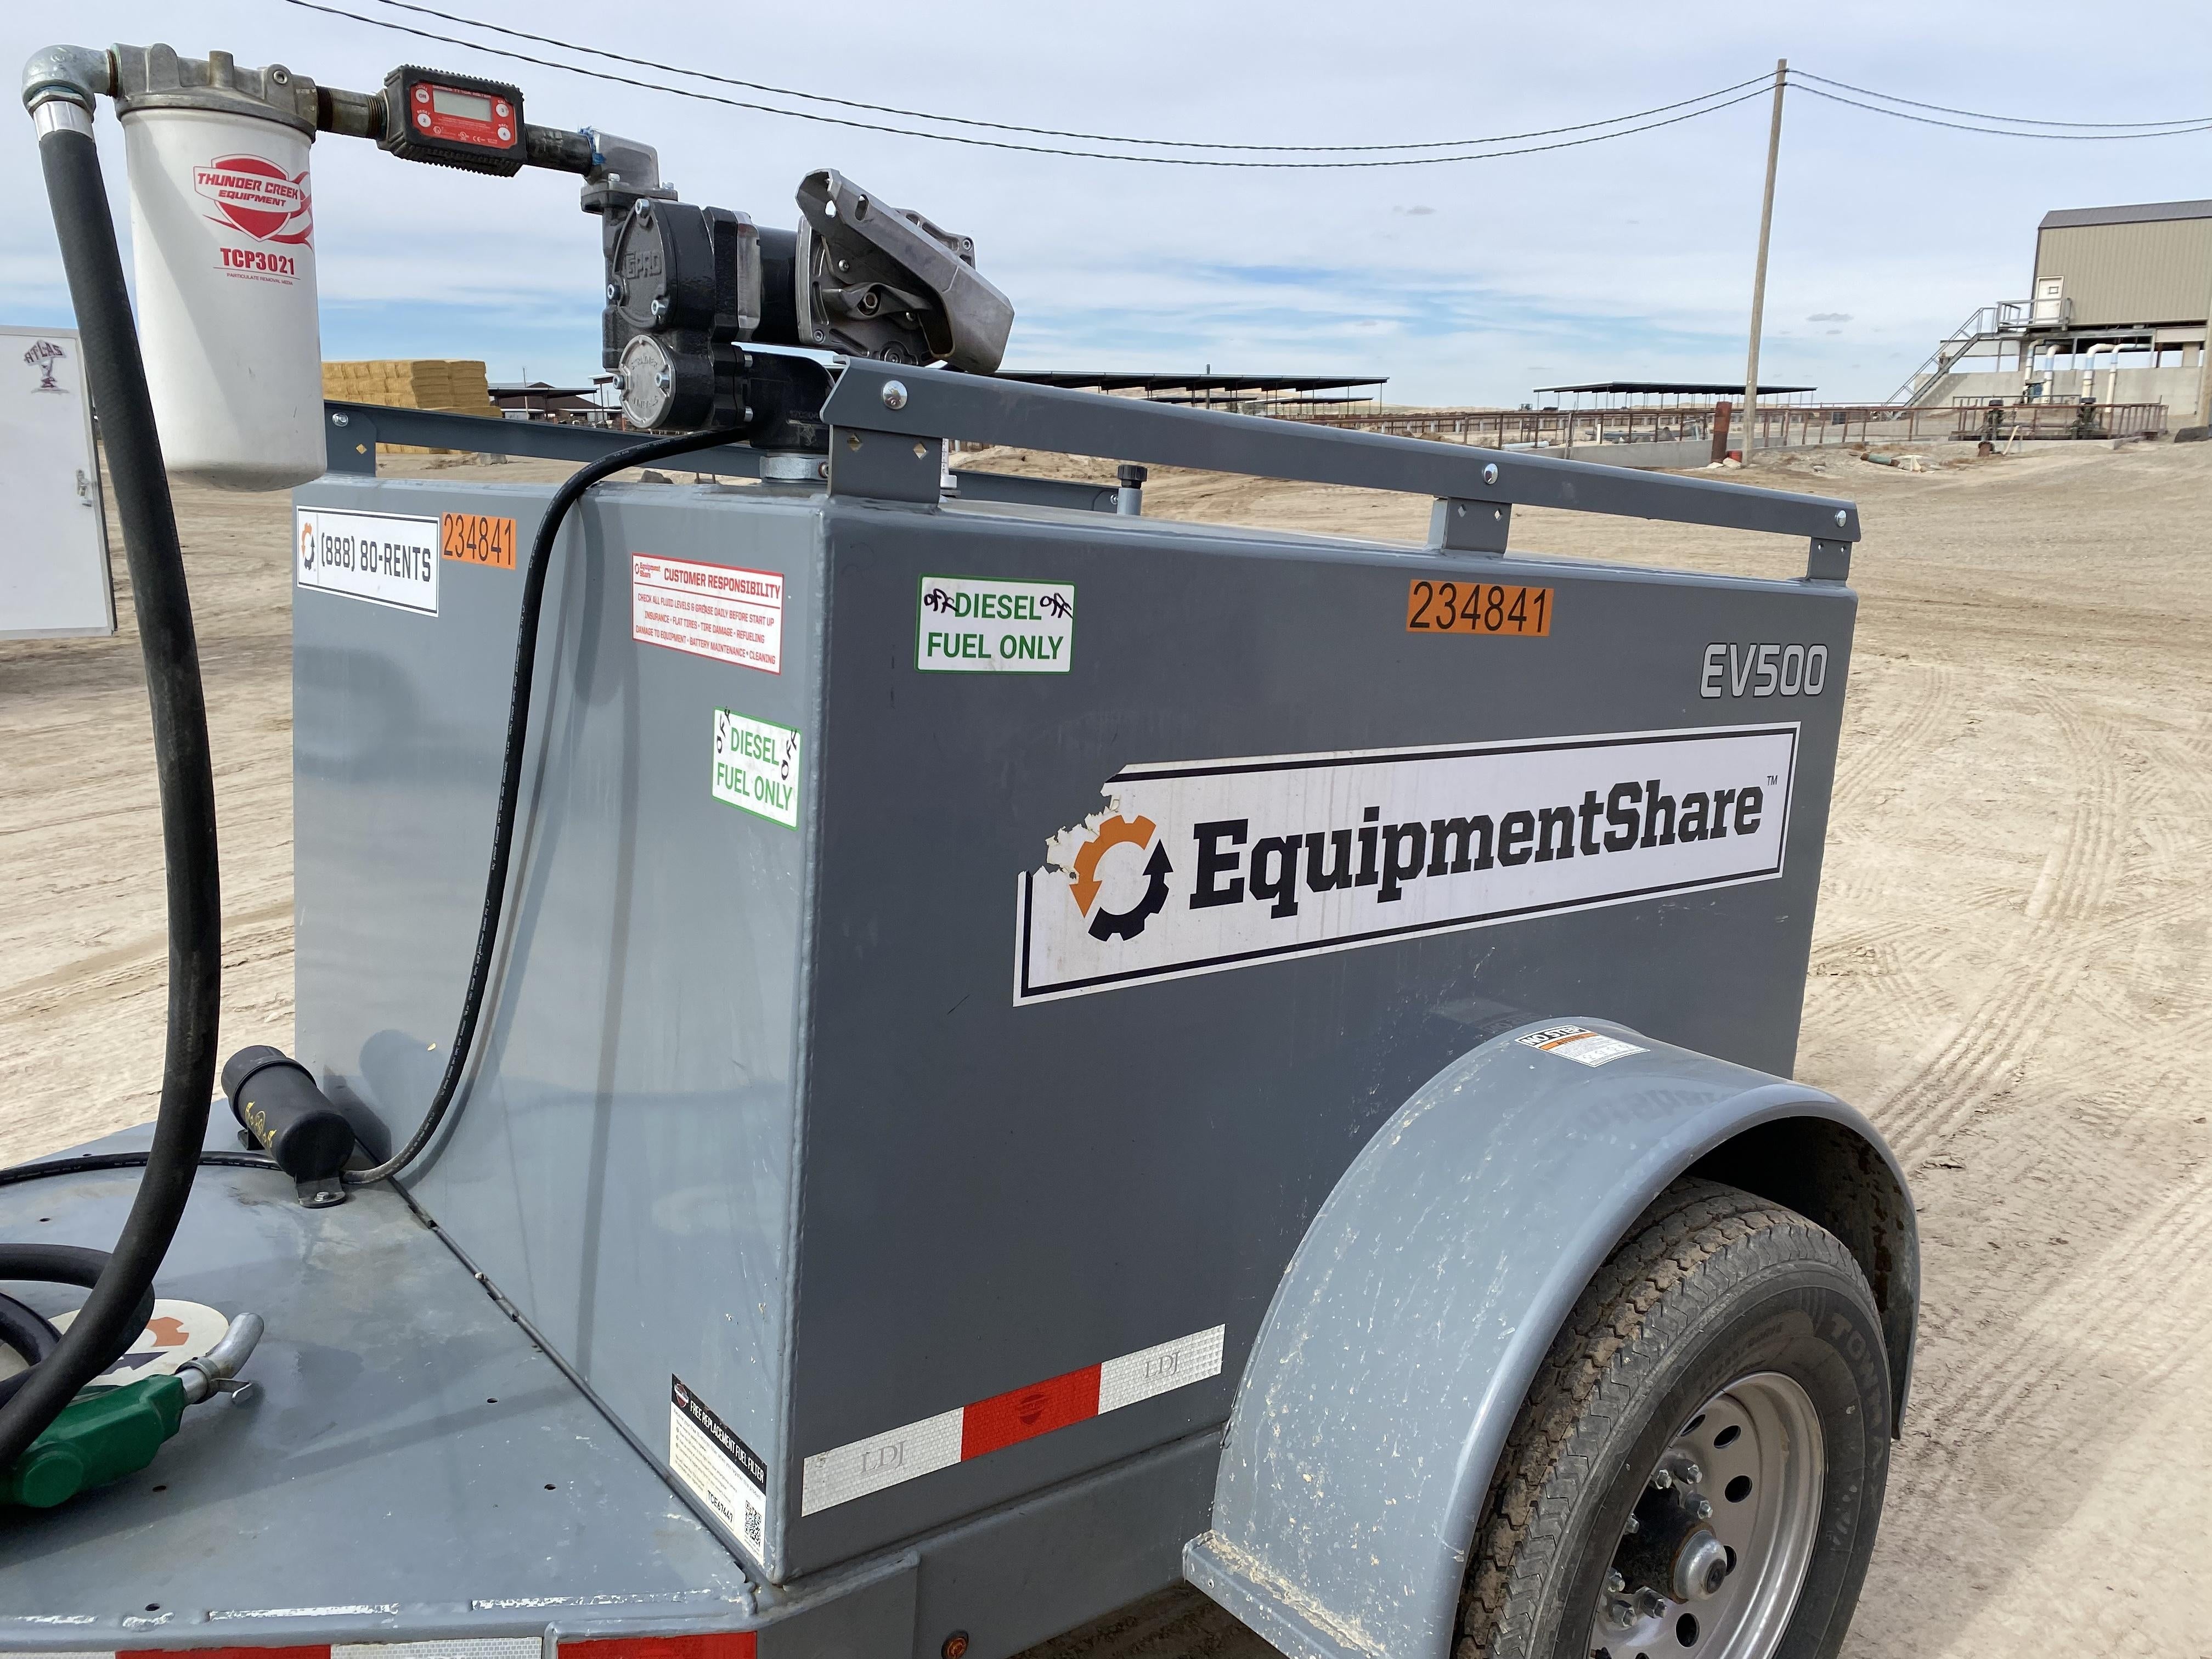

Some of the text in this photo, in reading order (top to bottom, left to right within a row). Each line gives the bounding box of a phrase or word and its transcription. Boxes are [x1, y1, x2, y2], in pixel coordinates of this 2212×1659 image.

[198, 173, 298, 200] THUNDER CREEK
[218, 190, 286, 207] EQUIPMENT
[220, 247, 295, 275] TCP3021
[227, 273, 259, 281] PARTICULATE
[24, 341, 63, 363] ATLAS
[321, 532, 432, 582] (888) 80-RENTS
[443, 514, 512, 565] 234841
[664, 567, 780, 599] CUSTOMER RESPONSIBILITY
[637, 592, 651, 603] CHECK
[661, 597, 673, 607] FLUID
[674, 600, 690, 611] LEVELS
[695, 603, 713, 615] GREASE
[714, 607, 728, 618] DAILY
[729, 610, 748, 622] BEFORE
[749, 613, 765, 625] START
[766, 617, 774, 627] UP
[955, 592, 1042, 620] DIESEL
[1409, 582, 1548, 633] 234841
[636, 624, 776, 664] DAMAGE TO EQUIPMENT BATTERY MAINTENANCE CLEANING
[645, 610, 765, 644] INSURANCE FLAT TIRES TIRE DAMAGE REFUELING
[927, 632, 1064, 659] FUEL ONLY
[1699, 642, 1829, 699] EV500
[731, 727, 780, 766] DIESEL
[718, 762, 793, 811] FUEL ONLY
[1189, 779, 1764, 919] EquipmentShare
[1521, 1032, 1547, 1046] NO
[1547, 1026, 1581, 1040] STEP
[1144, 1351, 1181, 1380] LDJ
[690, 1398, 702, 1422] FREE
[702, 1410, 736, 1455] REPLACEMENT
[735, 1443, 747, 1468] FUEL
[747, 1455, 764, 1485] FILTER
[860, 1440, 905, 1475] LDJ
[707, 1488, 733, 1525] TCE67447
